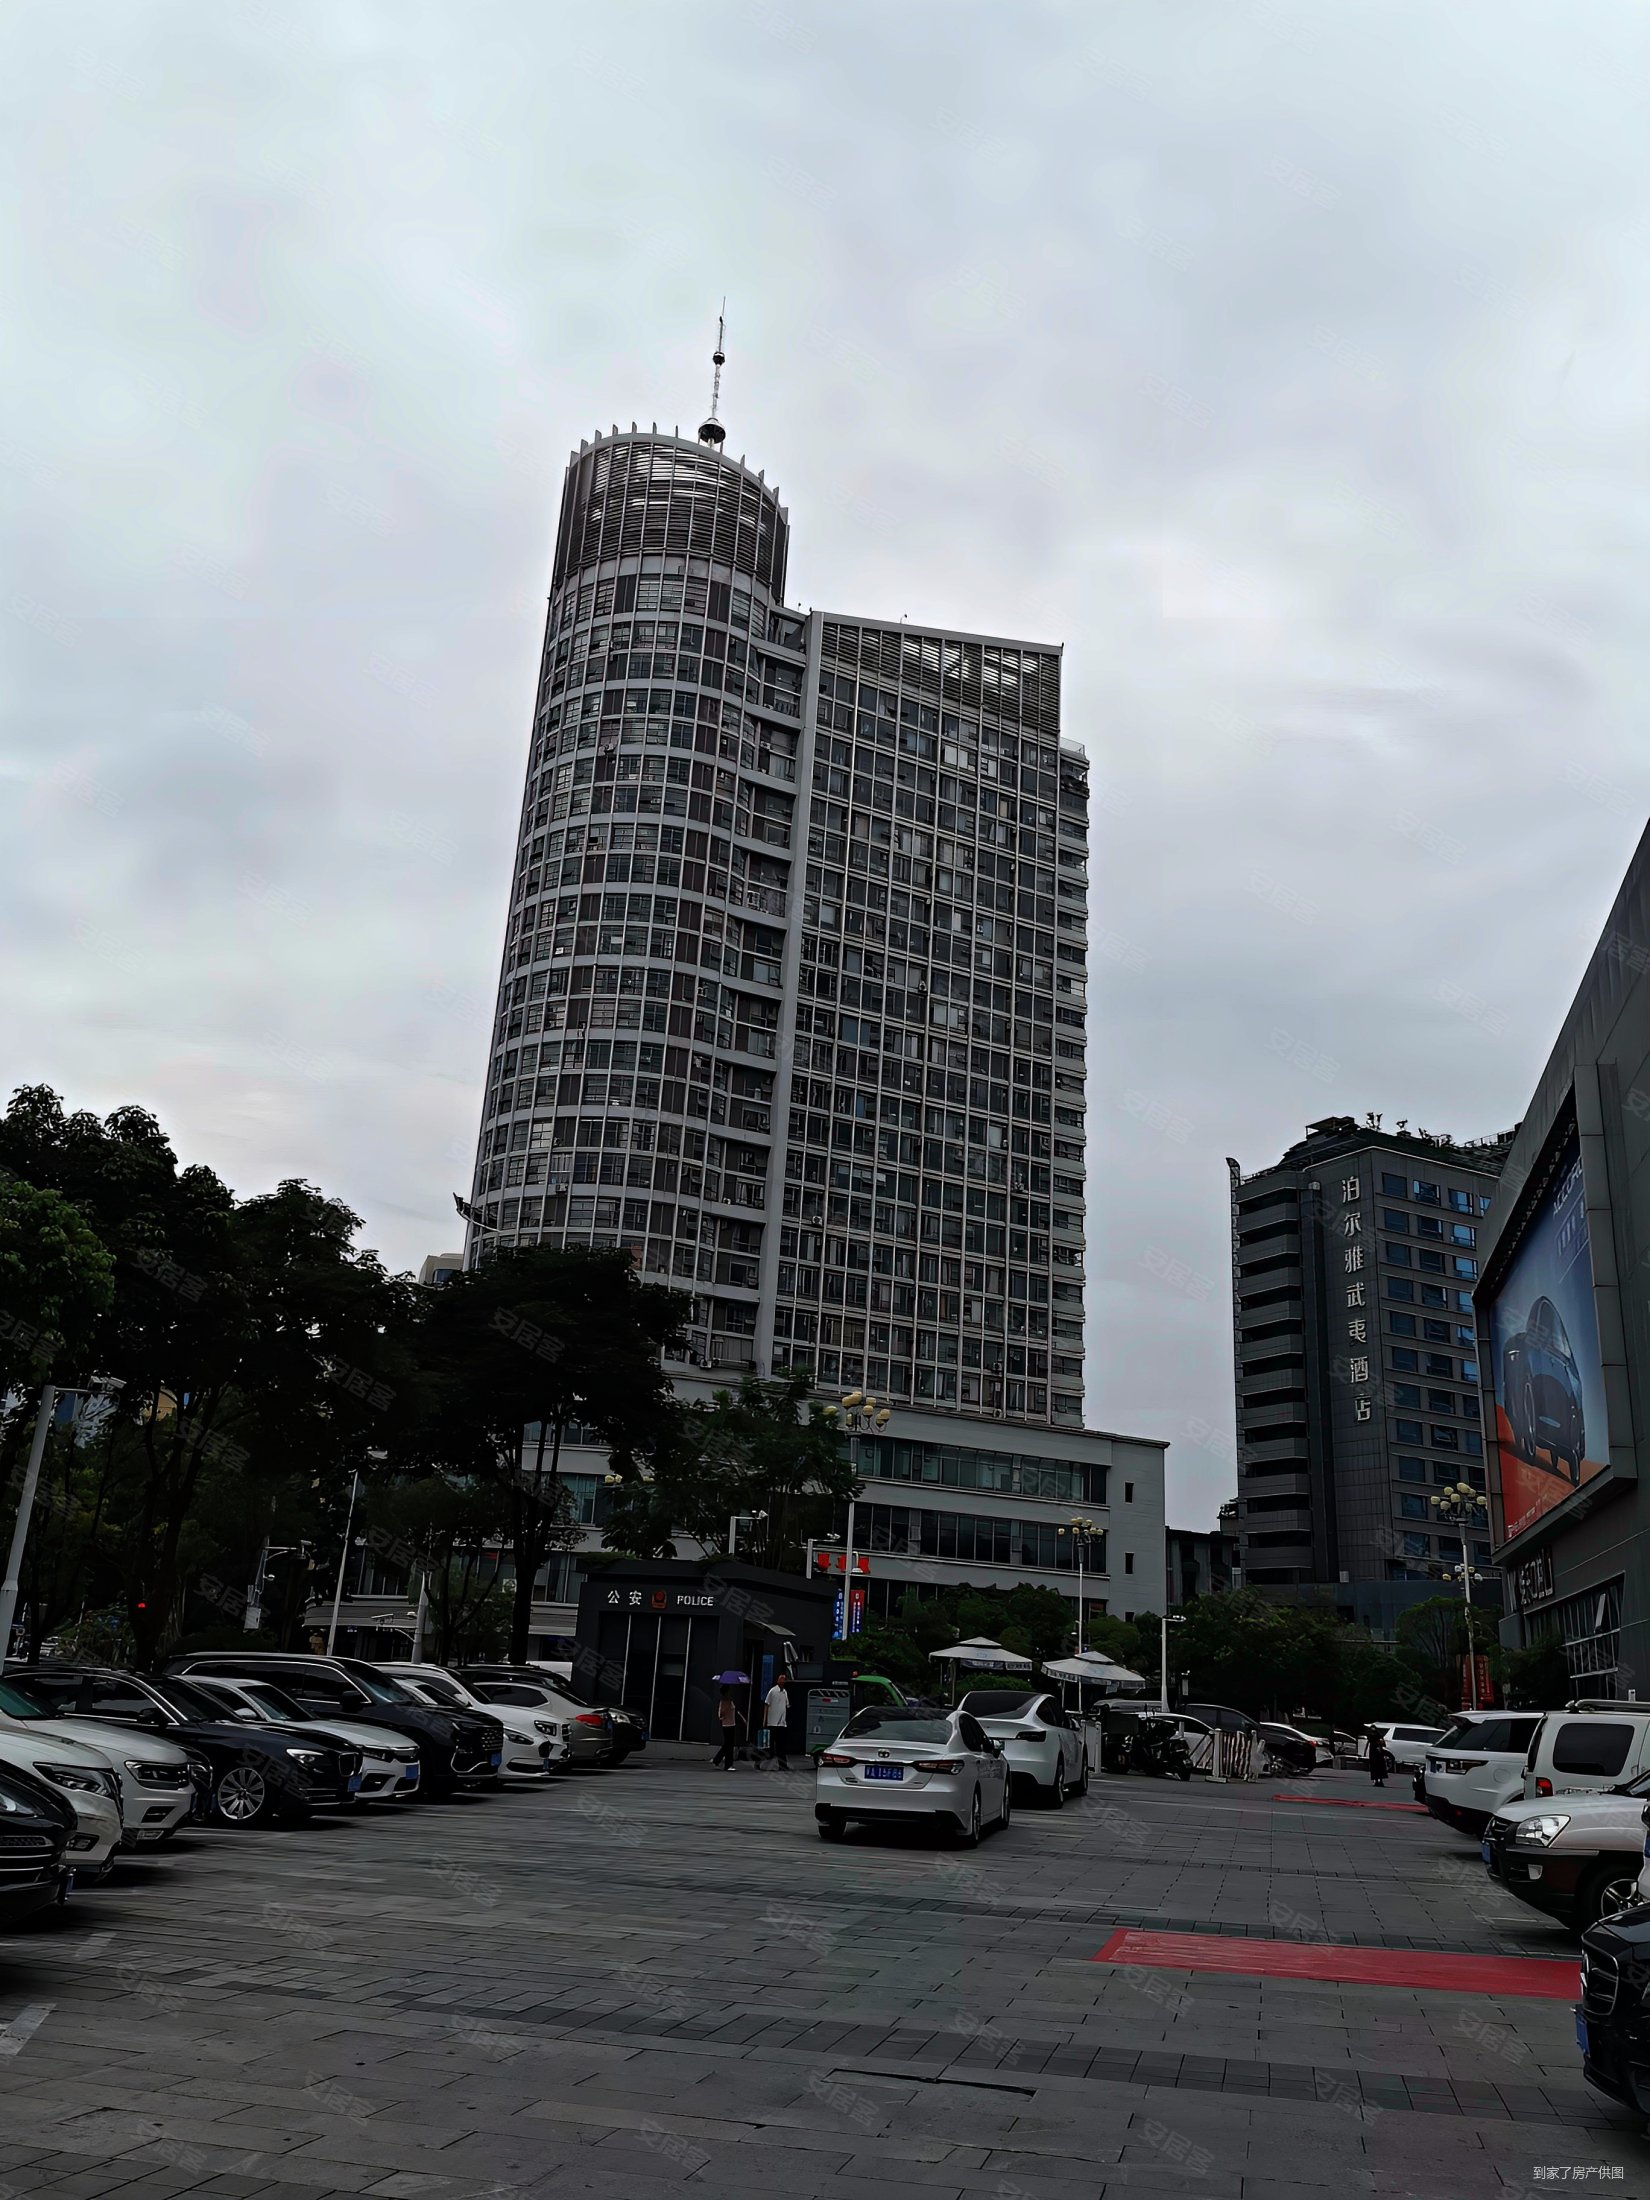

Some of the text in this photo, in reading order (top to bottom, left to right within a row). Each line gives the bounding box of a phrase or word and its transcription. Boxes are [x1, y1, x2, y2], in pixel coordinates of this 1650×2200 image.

[1342, 1176, 1372, 1421] 泊尔雅武夷酒店
[607, 1589, 642, 1606] 公安
[676, 1595, 714, 1606] POLICE
